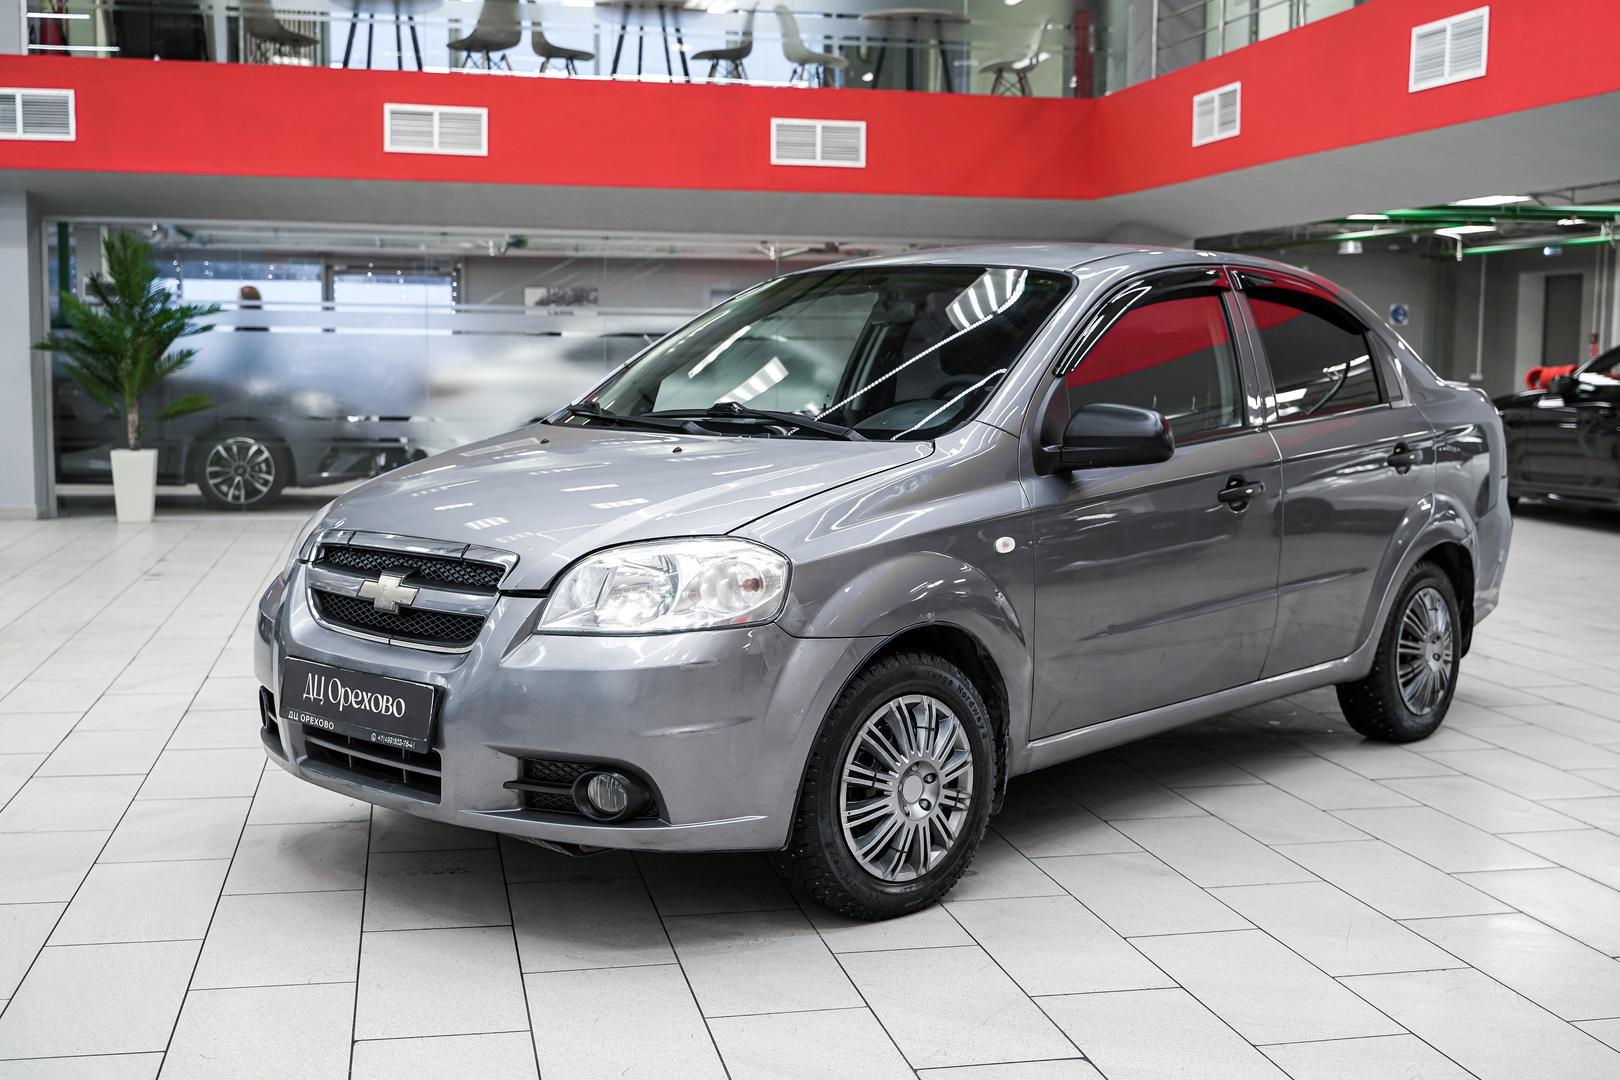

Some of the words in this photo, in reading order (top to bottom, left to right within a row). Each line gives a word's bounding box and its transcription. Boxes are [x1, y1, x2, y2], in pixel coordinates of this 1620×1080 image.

[302, 672, 325, 705] ДЦ
[328, 677, 406, 718] Орехово
[288, 710, 299, 720] ДЦ
[300, 713, 335, 730] ОРЕХОВО
